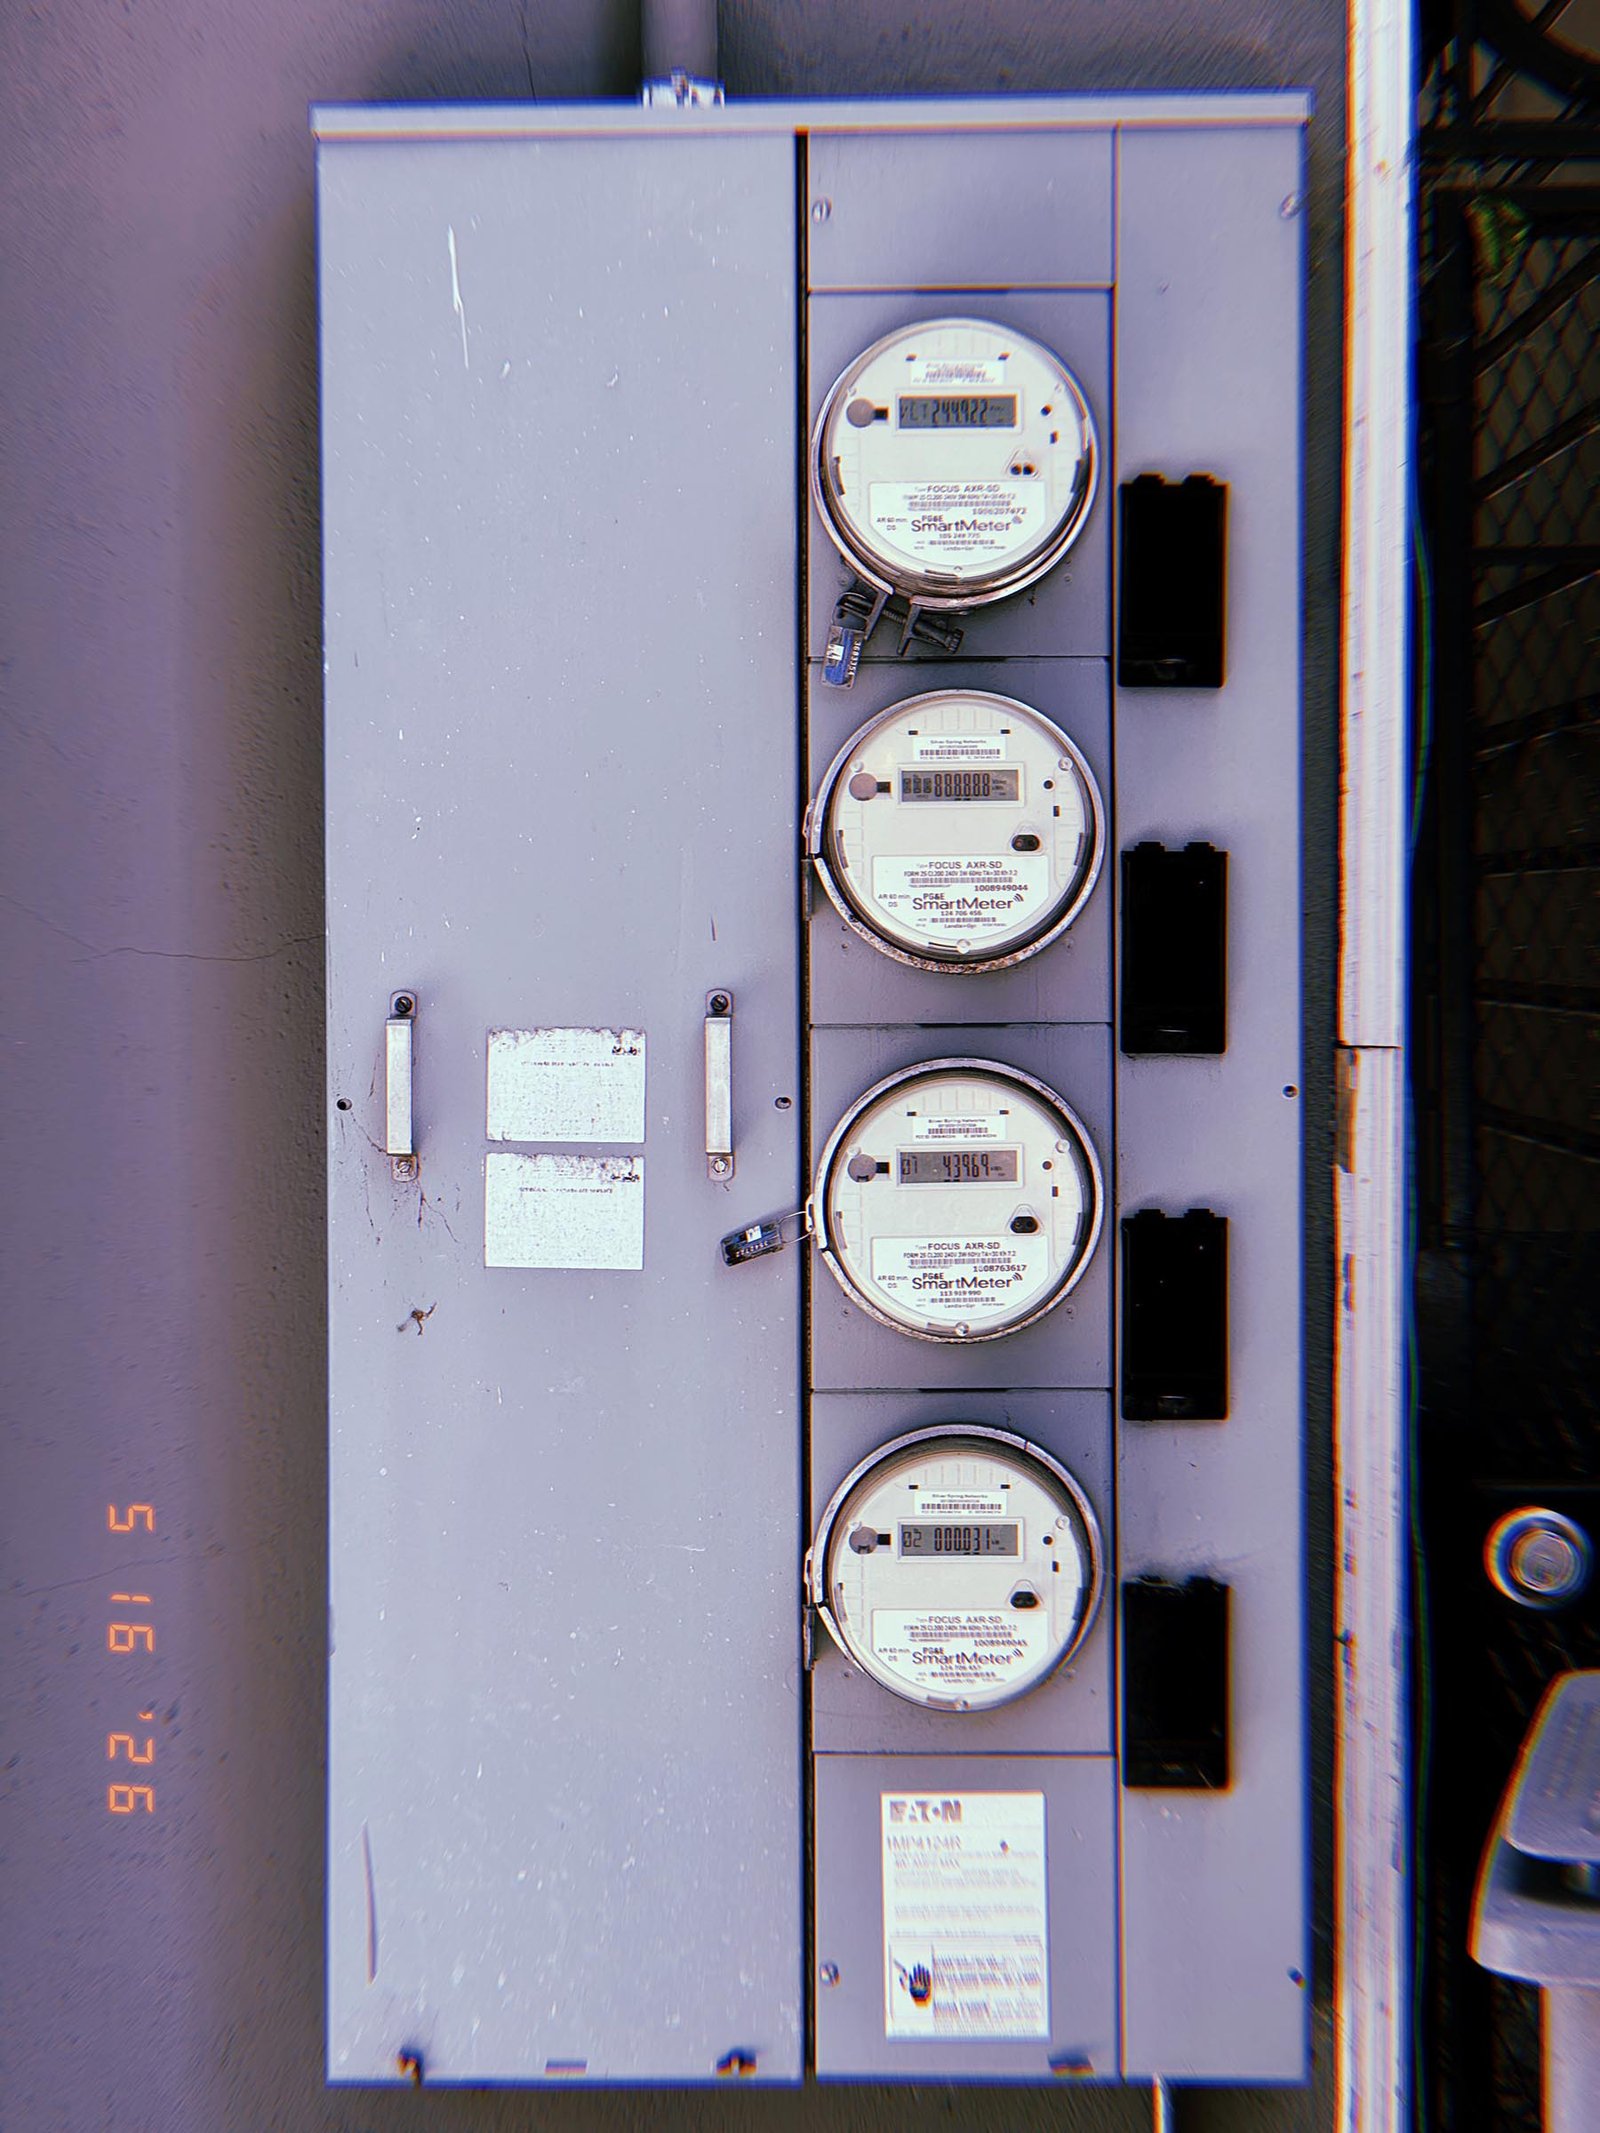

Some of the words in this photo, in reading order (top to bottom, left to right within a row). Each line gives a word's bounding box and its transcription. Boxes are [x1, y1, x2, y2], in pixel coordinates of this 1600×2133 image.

[964, 484, 1000, 492] AXR-SD
[911, 519, 1012, 532] SmartMeter
[966, 861, 1002, 869] AXR-SD
[912, 897, 1014, 910] SmartMeter
[943, 1154, 989, 1178] 43969
[912, 1276, 1012, 1290] SmartMeter
[928, 1616, 962, 1624] FOCUS
[966, 1616, 1002, 1624] AXR-SD
[912, 1652, 1012, 1665] SmartMeter
